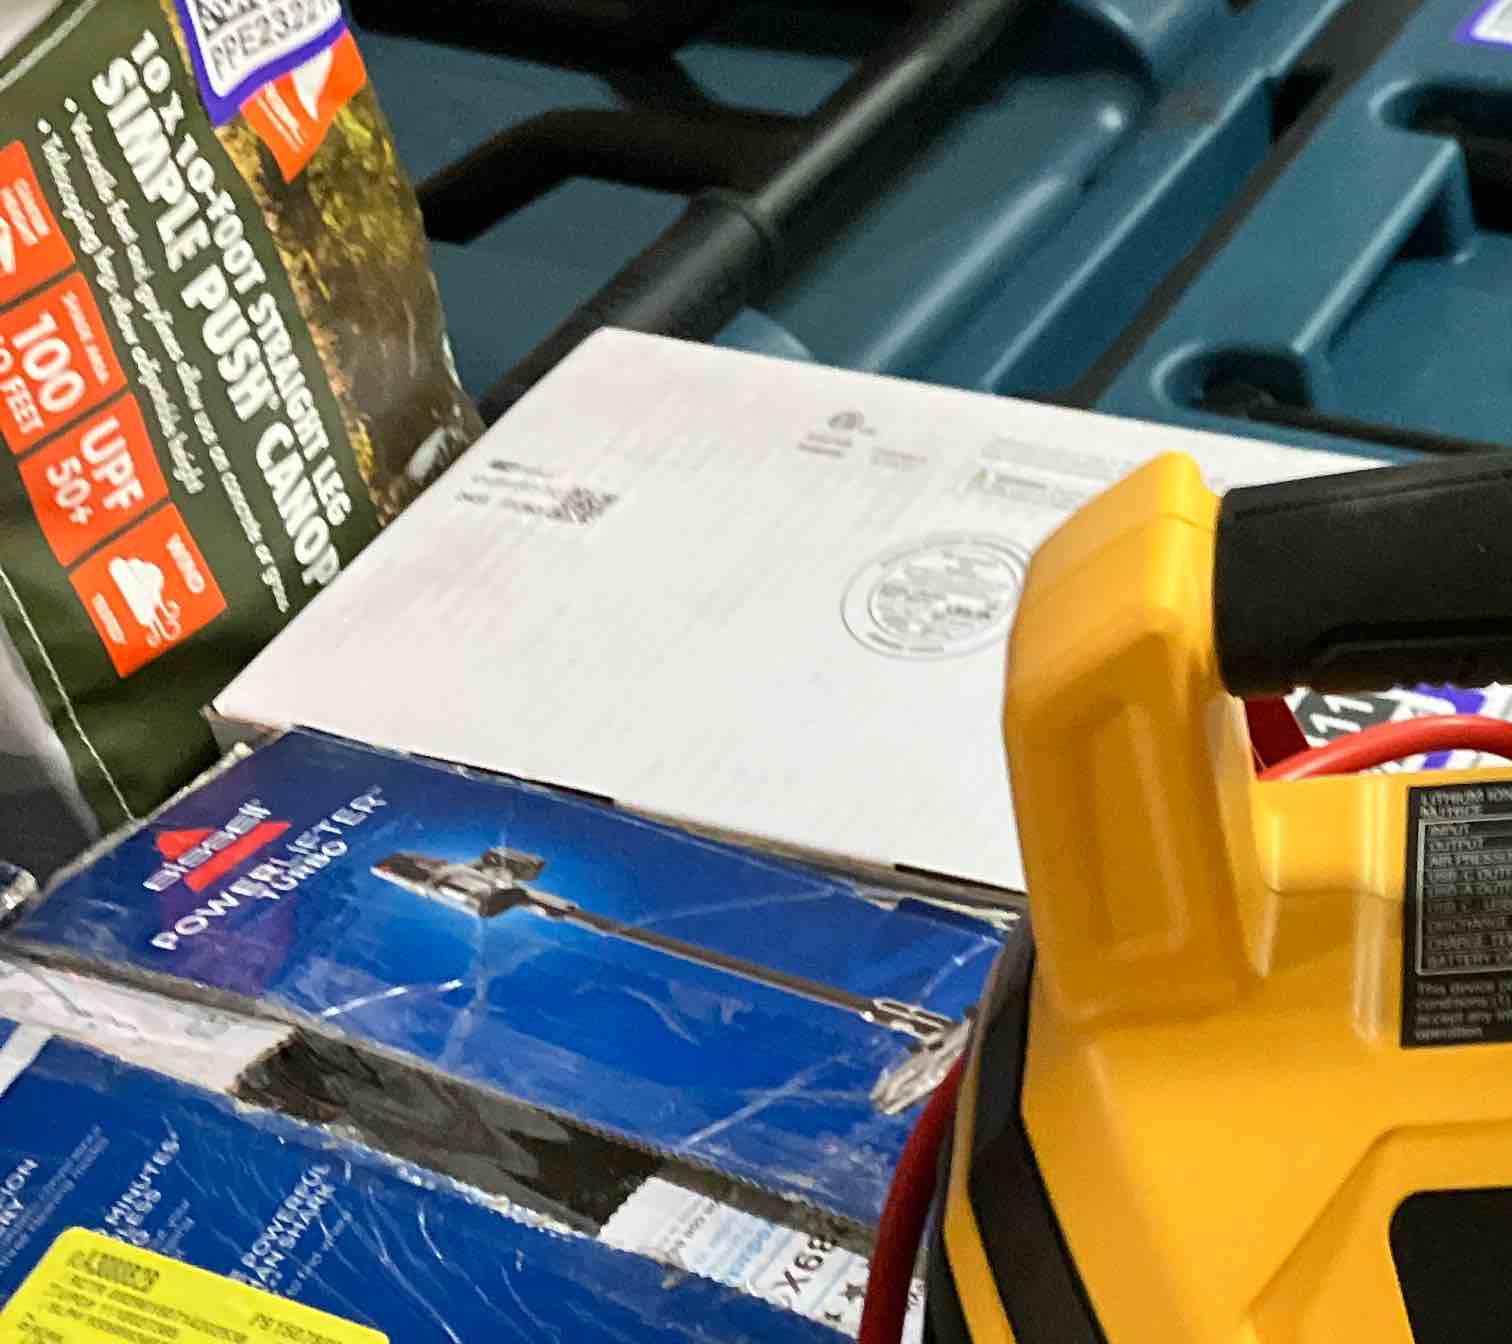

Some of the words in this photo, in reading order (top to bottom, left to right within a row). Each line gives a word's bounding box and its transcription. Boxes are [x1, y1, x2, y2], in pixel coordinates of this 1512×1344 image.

[86, 54, 213, 271] SIMPLE
[174, 261, 280, 423] PUSH
[246, 418, 349, 592] CANOP
[124, 29, 177, 97] 10
[243, 293, 333, 461] STRAIGHT
[304, 455, 358, 528] LEG
[4, 307, 92, 418] 100
[41, 454, 103, 532] 50+
[72, 414, 152, 516] UPF
